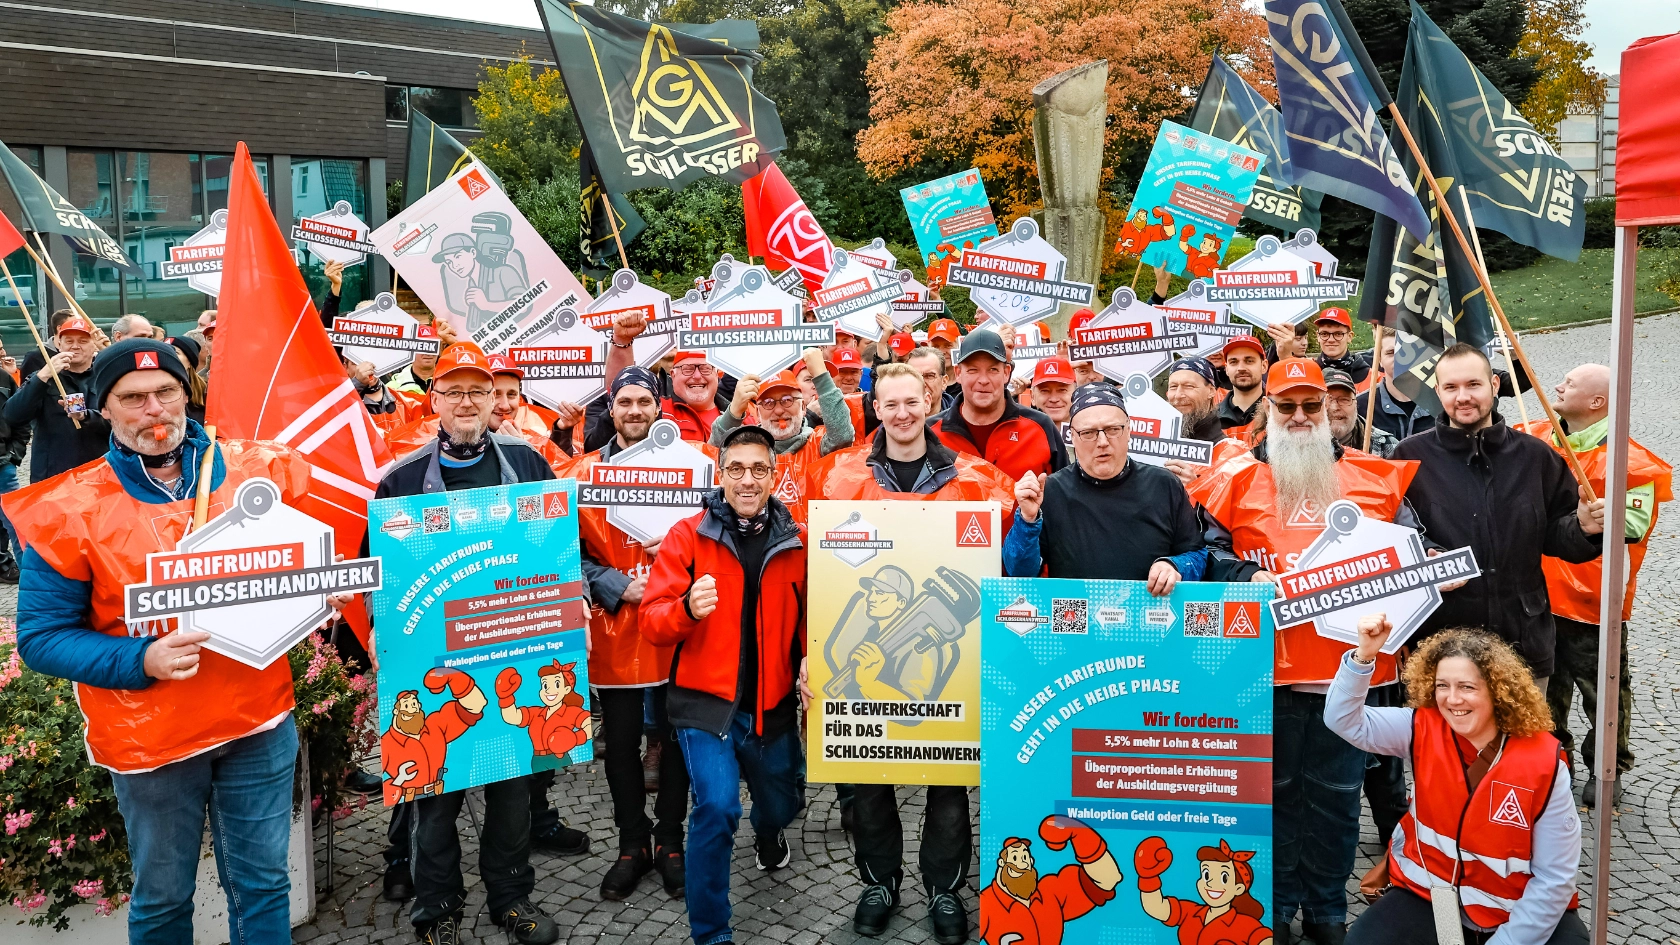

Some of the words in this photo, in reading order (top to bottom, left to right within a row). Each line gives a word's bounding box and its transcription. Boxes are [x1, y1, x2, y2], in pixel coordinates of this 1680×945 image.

[626, 143, 760, 180] SCHLOSSER
[304, 221, 353, 238] TARIFRUNDE
[295, 230, 383, 256] SCHLOSSERHANDWER
[176, 246, 225, 260] TARIFRU
[167, 260, 223, 275] SCHLOSSE
[967, 254, 1040, 276] TARIFRUNDE
[953, 270, 1087, 301] SCHLOSSERHANDWERK
[1220, 273, 1292, 285] TARIFRUNDE
[820, 280, 868, 304] TARIFRUNDE
[1210, 285, 1342, 300] SCHLOSSERHANDWERK
[472, 328, 489, 343] DIE
[487, 280, 548, 333] GEWERKSCHAFT
[820, 286, 901, 319] SCHLOSSERHANDWERK
[338, 321, 399, 336] TARIFRUNDE
[696, 313, 775, 327] TARIFRUNDE
[1169, 322, 1249, 336] OSSERHANDWERK
[328, 333, 436, 352] SCHLOSSERHANDWERK
[482, 338, 501, 354] FÜR
[498, 324, 517, 342] DAS
[683, 328, 829, 347] SCHLOSSERHANDWERK
[1081, 326, 1147, 342] TARIFRUNDE
[513, 350, 586, 362] TARIFRUNDE
[1074, 336, 1195, 359] SCHLOSSERHANDWERK
[598, 469, 685, 485] TARIFRUNDE
[582, 488, 703, 505] SCHLOSSERHAND
[822, 541, 892, 549] SCHLOSSERHANDWERK
[160, 548, 293, 580] TARIFRUNDE
[1287, 553, 1391, 594] TARIFRUNDE
[396, 573, 430, 612] UNSERE
[428, 540, 494, 576] TARIFRUNDE
[494, 578, 514, 590] Wir
[516, 573, 560, 587] fordern:
[137, 566, 374, 613] SCHLOSSERHANDWERK
[403, 607, 425, 636] GEHT
[421, 594, 436, 608] IN
[433, 579, 451, 597] DIE
[484, 554, 519, 569] PHASE
[1280, 555, 1471, 622] SCHLOSSERHANDWERK
[468, 599, 487, 610] 5,5%
[489, 597, 508, 607] mehr
[509, 593, 528, 604] Lohn
[529, 592, 535, 600] &
[536, 588, 560, 599] Gehalt
[455, 613, 526, 632] Überproportionale
[527, 607, 562, 621] Erhöhung
[464, 632, 478, 642] der
[479, 619, 562, 640] Ausbildungsvergütung
[444, 653, 490, 668] Wahloption
[490, 649, 508, 660] Geld
[509, 646, 527, 656] oder
[528, 642, 545, 654] freie
[546, 640, 564, 652] Tage
[1009, 685, 1056, 733] UNSERE
[1054, 655, 1146, 691] TARIFRUNDE
[825, 702, 848, 716] DIE
[851, 703, 961, 718] GEWERKSCHAFT
[825, 720, 852, 737] FÜR
[855, 724, 883, 737] DAS
[1016, 729, 1046, 765] GEHT
[1042, 714, 1061, 733] IN
[1059, 698, 1084, 721] DIE
[1085, 681, 1128, 707] HEIßE
[1131, 679, 1180, 694] PHASE
[1143, 712, 1170, 727] Wir
[1174, 711, 1239, 729] fordern:
[1105, 736, 1130, 747] 5,5%
[1133, 737, 1160, 748] mehr
[1163, 737, 1190, 749] Lohn
[1192, 738, 1200, 749] &
[1203, 738, 1238, 750] Gehalt
[825, 745, 980, 762] SCHLOSSERHANDWERK
[1084, 760, 1184, 777] Überproportionale
[1186, 765, 1237, 780] Erhöhung
[1096, 778, 1115, 789] der
[1116, 779, 1237, 795] Ausbildungsvergütung
[1067, 807, 1129, 822] Wahloption
[1130, 809, 1155, 821] Geld
[1157, 811, 1182, 823] oder
[1184, 811, 1210, 824] freie
[1212, 813, 1237, 826] Tage
